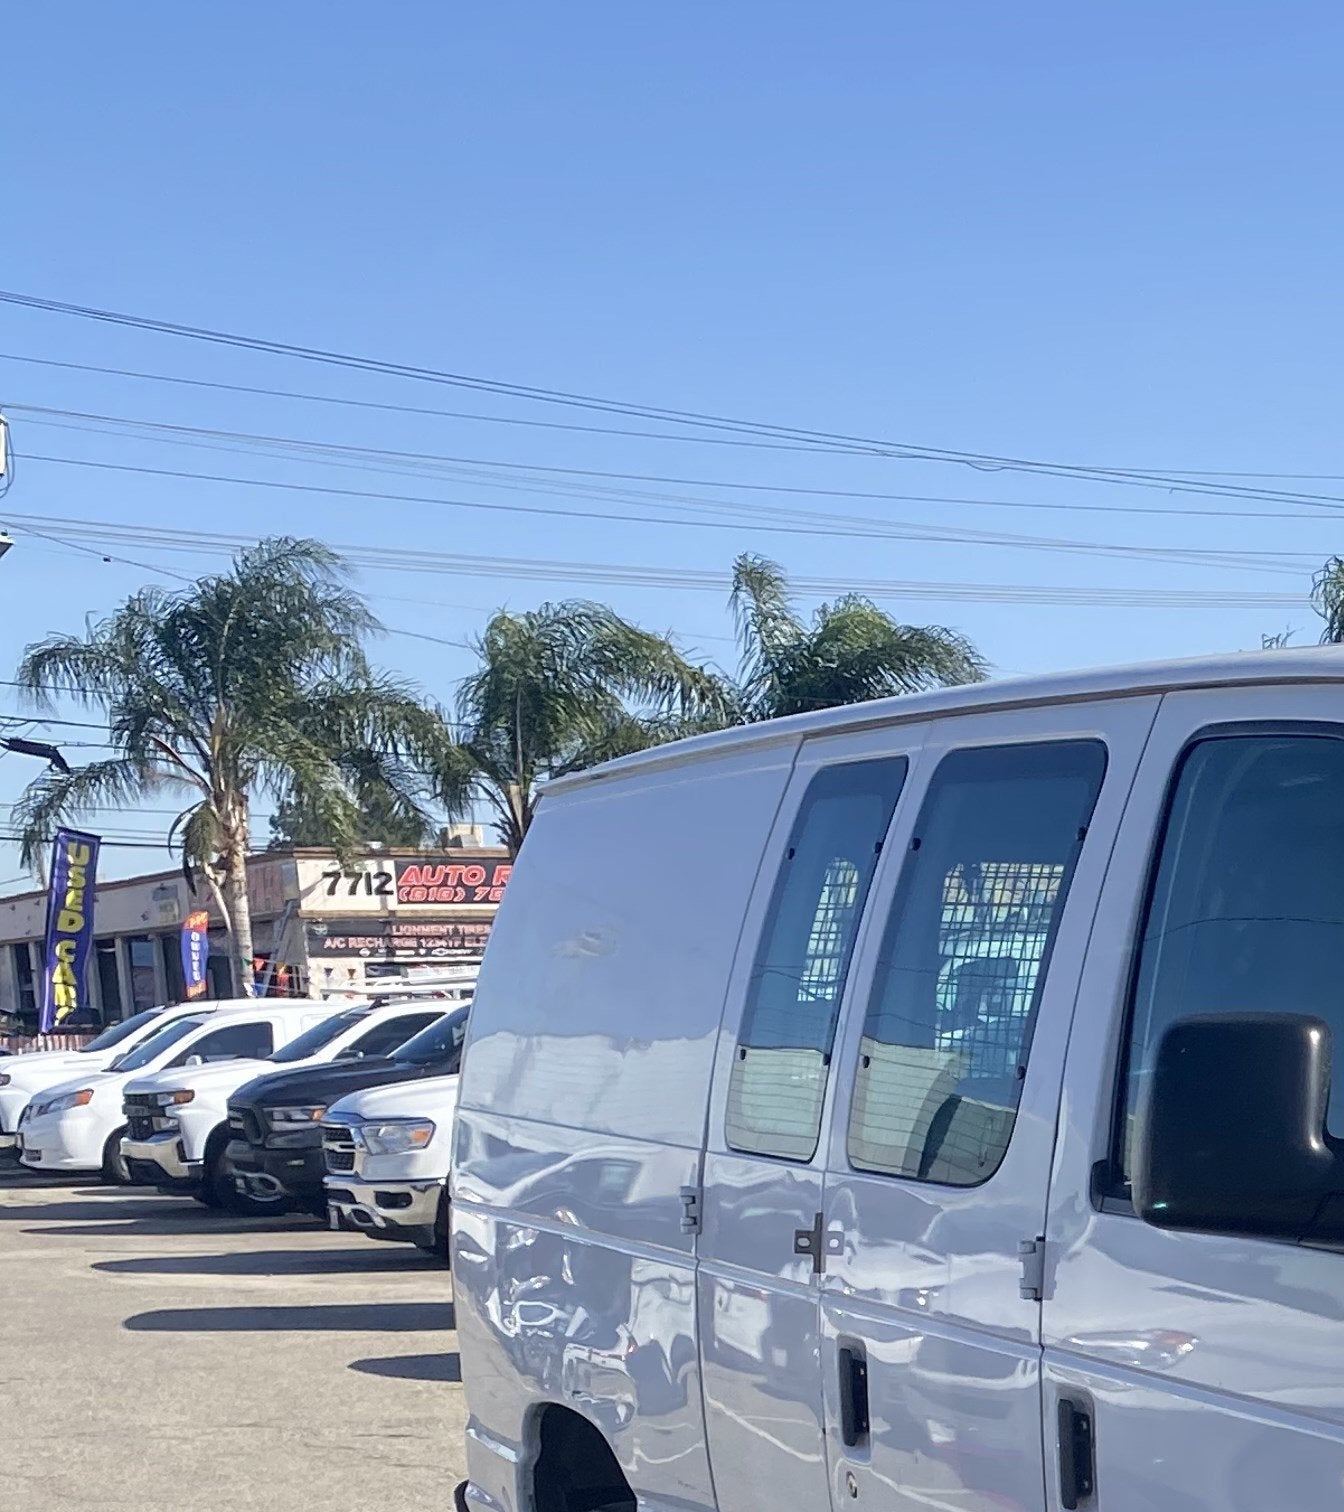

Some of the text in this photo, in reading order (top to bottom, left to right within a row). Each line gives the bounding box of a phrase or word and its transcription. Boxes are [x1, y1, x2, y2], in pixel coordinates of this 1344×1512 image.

[321, 871, 394, 896] 7712
[397, 864, 487, 886] AUTO
[57, 842, 90, 933] USED
[323, 938, 346, 949] A/C
